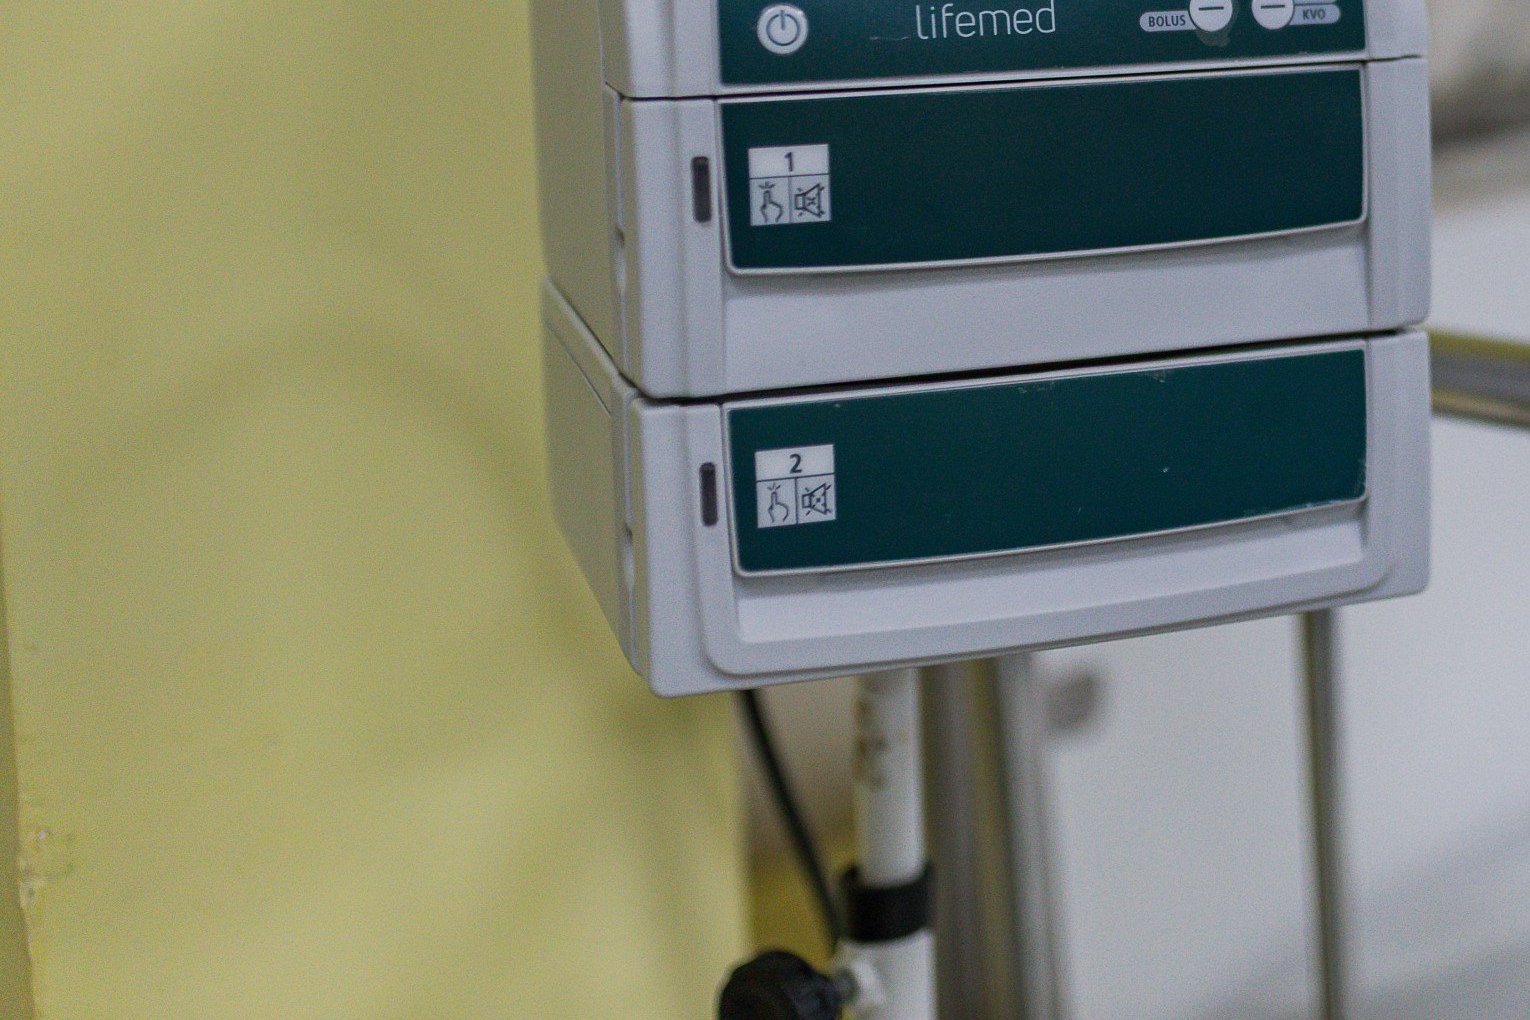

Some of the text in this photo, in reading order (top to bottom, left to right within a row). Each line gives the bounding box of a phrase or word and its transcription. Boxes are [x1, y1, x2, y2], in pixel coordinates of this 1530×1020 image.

[1147, 13, 1187, 28] BOLUS
[1302, 7, 1327, 21] KVO
[784, 151, 794, 172] 1
[789, 453, 803, 474] 2
